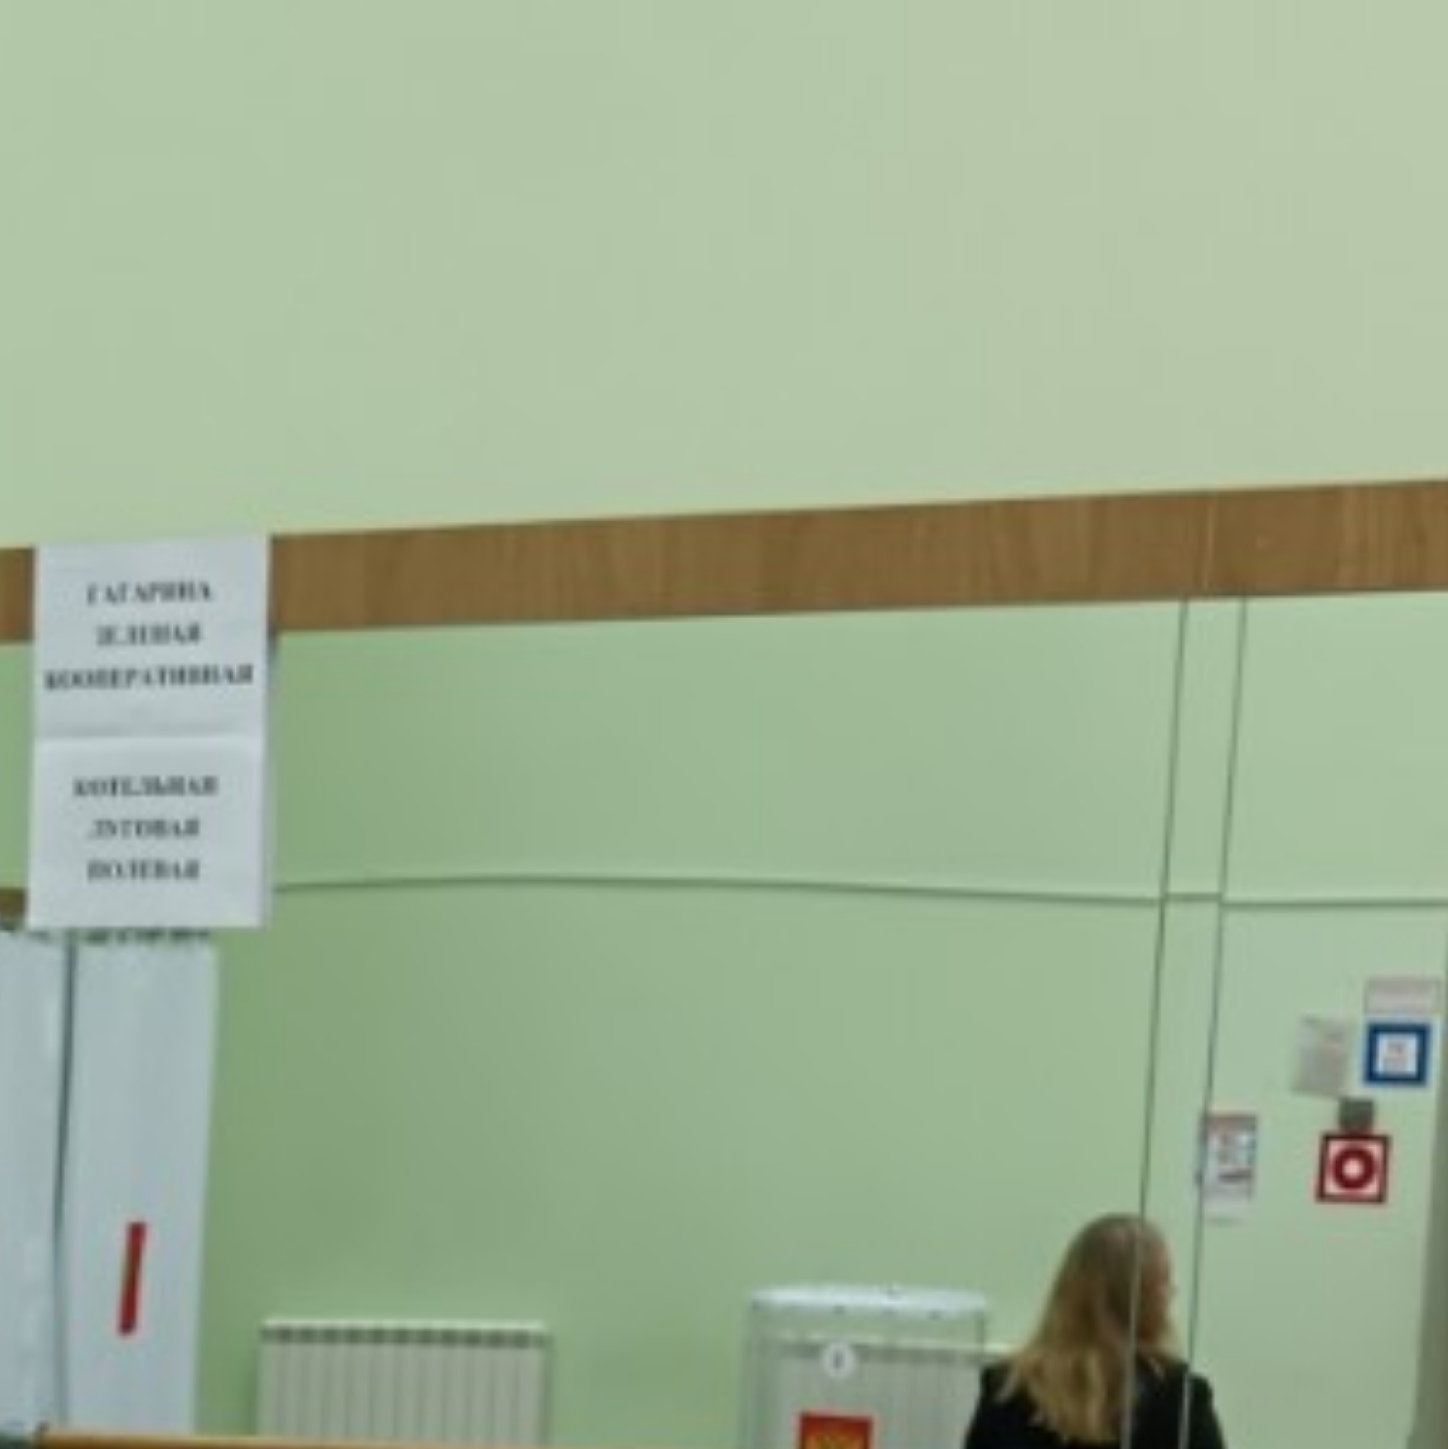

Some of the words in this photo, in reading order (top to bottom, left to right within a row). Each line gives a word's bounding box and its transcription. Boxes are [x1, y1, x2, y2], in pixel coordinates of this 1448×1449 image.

[87, 581, 211, 605] ГАГАРИНА
[44, 663, 254, 690] КООПЕРАТИВНАЯ
[73, 776, 219, 797] КОТЕЛЬНАЯ
[87, 818, 201, 840] ЛУГОВАЯ
[87, 860, 201, 882] ПОЛЕВАЯ
